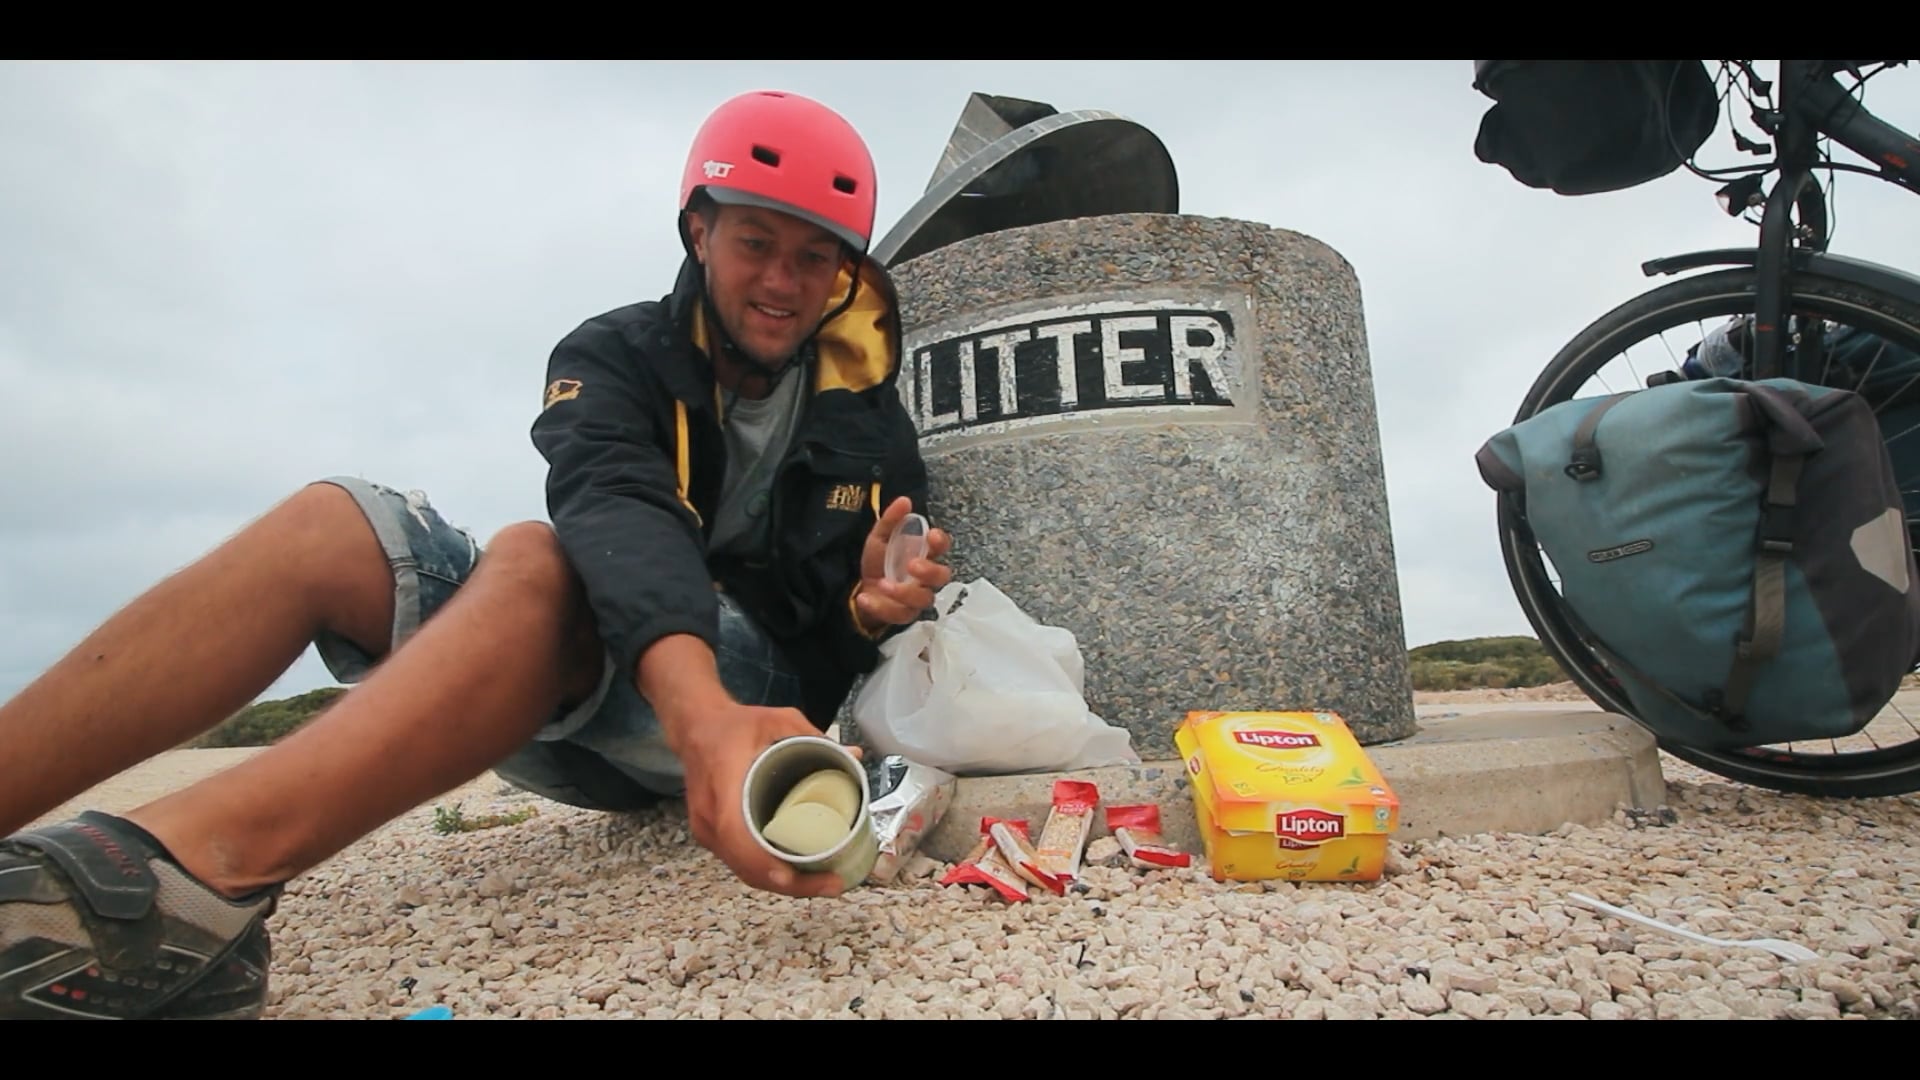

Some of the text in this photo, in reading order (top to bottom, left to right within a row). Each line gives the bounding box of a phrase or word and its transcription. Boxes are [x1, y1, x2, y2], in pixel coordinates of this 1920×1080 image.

[920, 316, 1232, 431] LITTER
[1240, 732, 1313, 746] Lipton
[1281, 817, 1339, 835] Lipton
